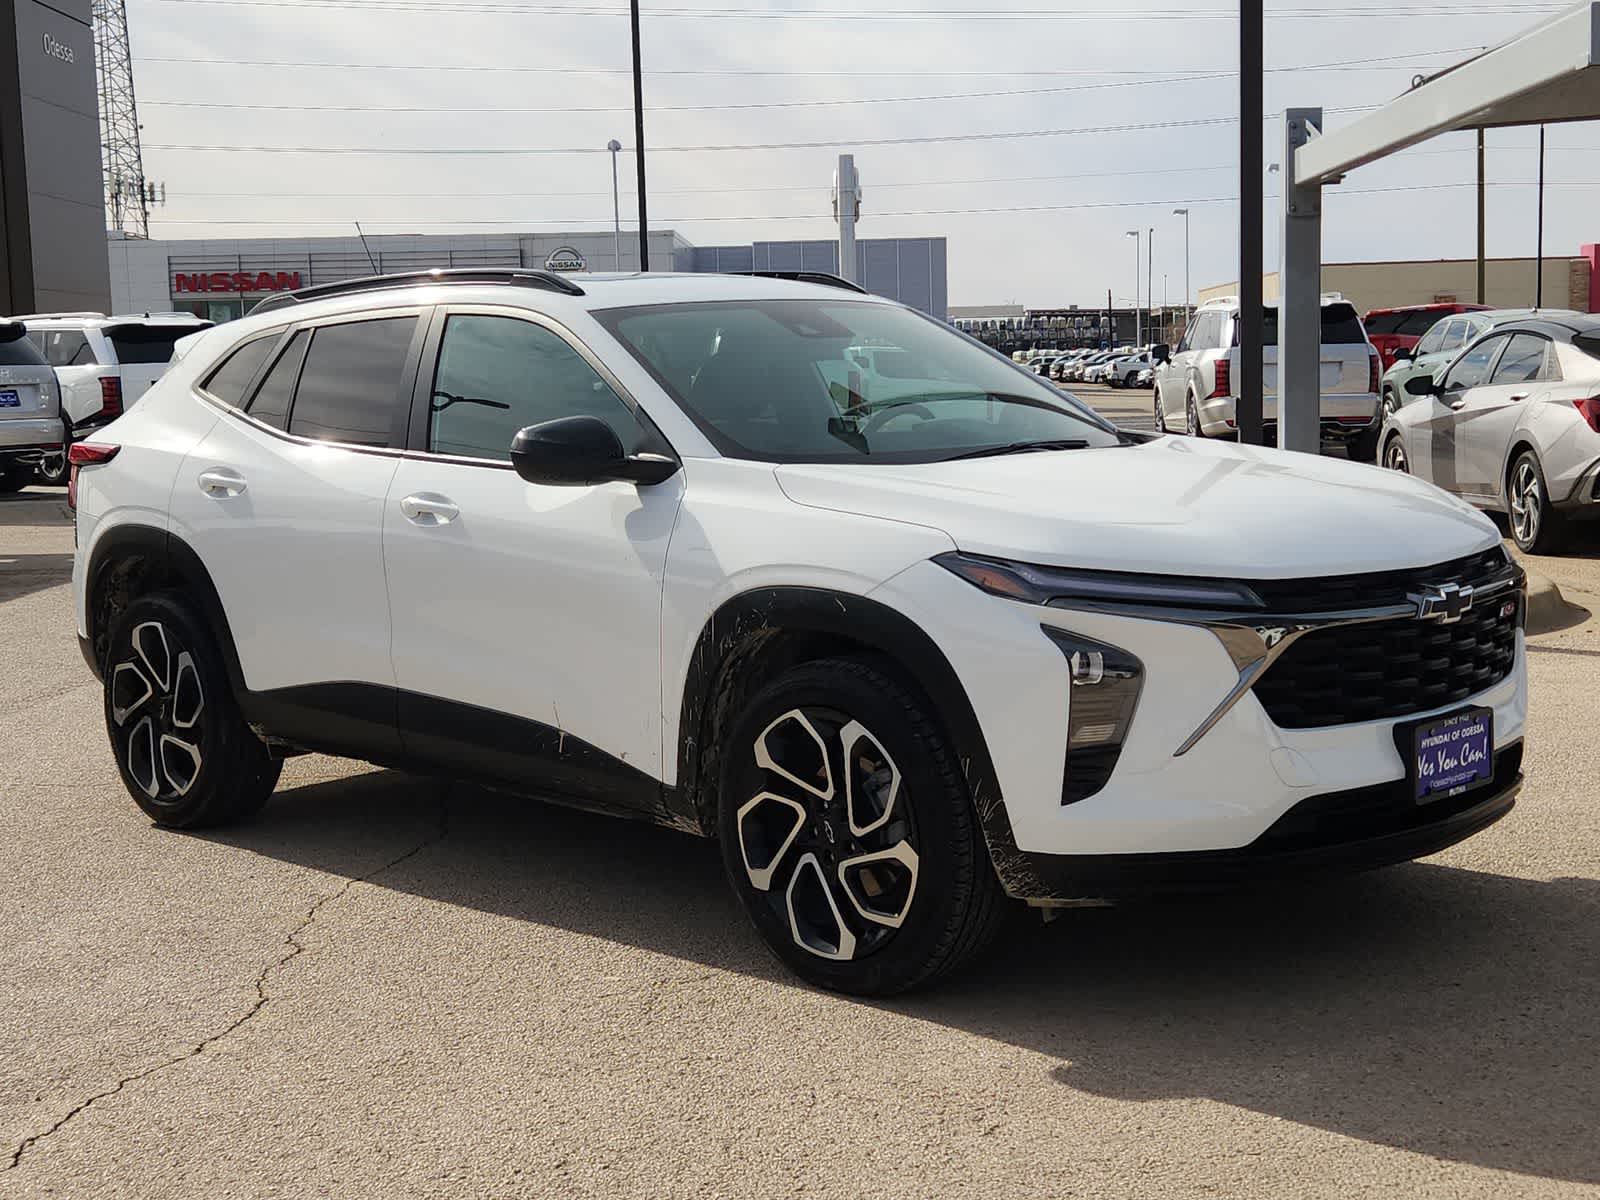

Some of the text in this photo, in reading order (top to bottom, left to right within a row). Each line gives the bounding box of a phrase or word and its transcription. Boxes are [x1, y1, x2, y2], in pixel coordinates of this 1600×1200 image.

[43, 33, 73, 63] Odessa
[175, 272, 300, 292] NISSAN
[1421, 724, 1485, 749] HYUNDAI OF ODESSA
[1417, 754, 1434, 779] Yes
[1438, 748, 1458, 773] You
[1460, 736, 1487, 767] Can!
